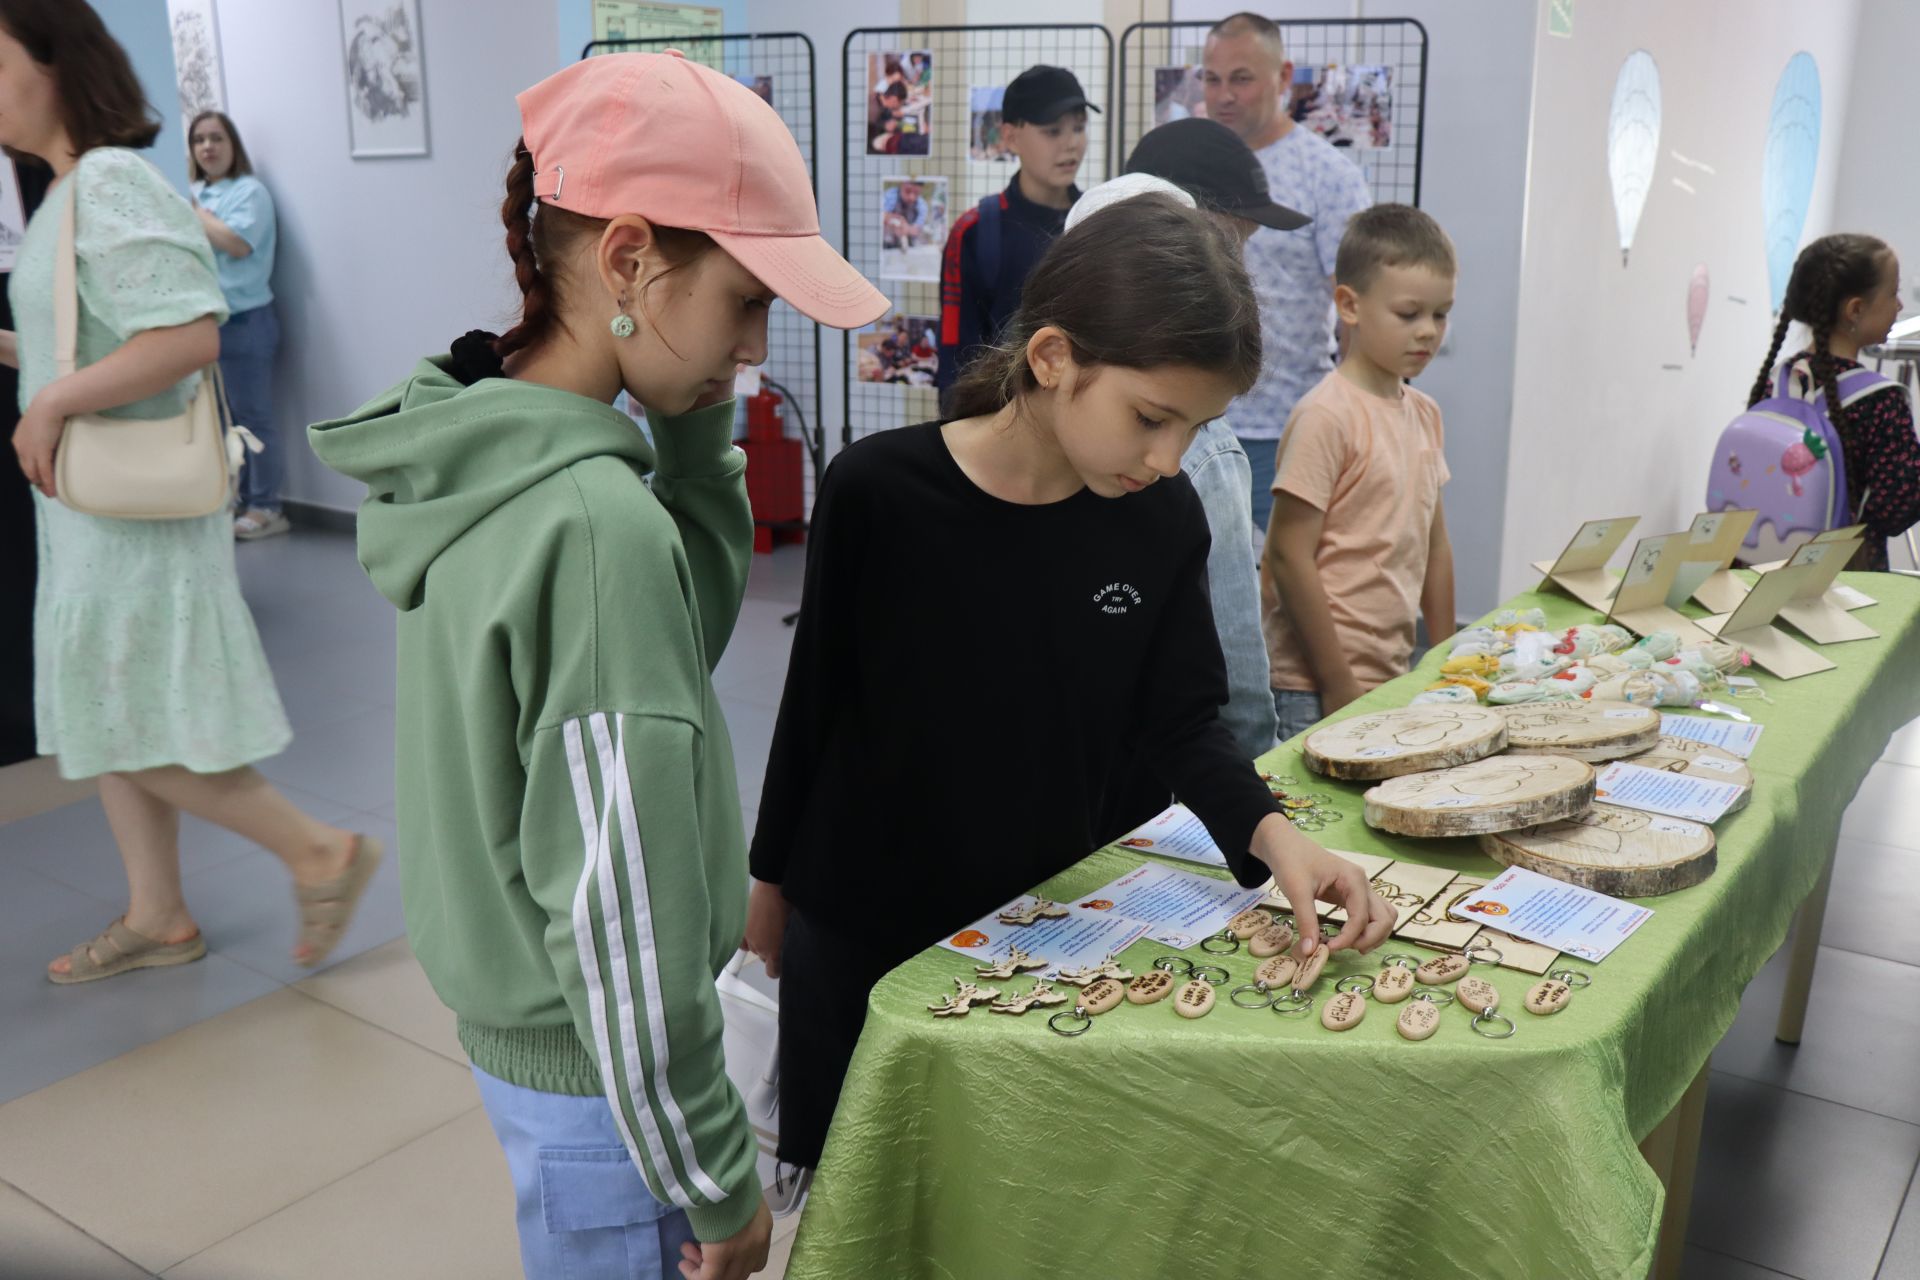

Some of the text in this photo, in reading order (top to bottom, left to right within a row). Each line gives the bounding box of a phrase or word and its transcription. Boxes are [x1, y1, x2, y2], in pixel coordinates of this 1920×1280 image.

[1093, 583, 1141, 605] GAME OVER
[1101, 604, 1127, 614] AGAIN
